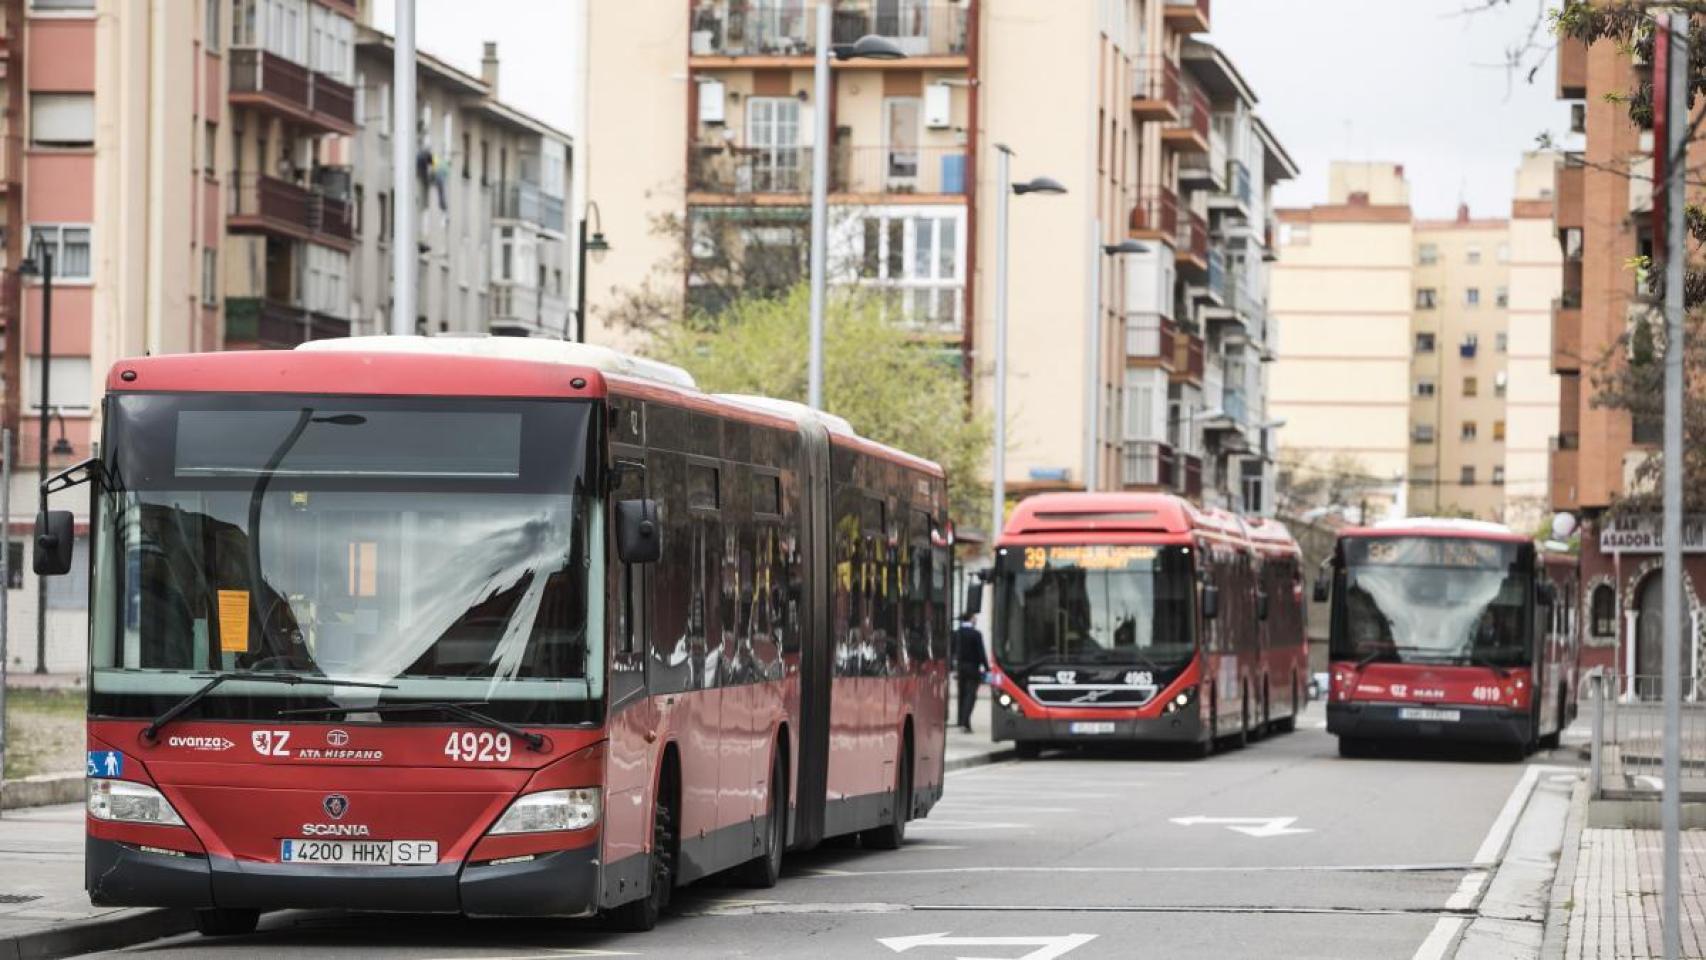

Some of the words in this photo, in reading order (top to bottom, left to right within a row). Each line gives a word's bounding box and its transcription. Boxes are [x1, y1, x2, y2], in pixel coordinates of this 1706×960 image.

[1603, 534, 1651, 546] ASADOR
[1024, 547, 1046, 570] 39
[1413, 689, 1445, 698] MAN
[168, 736, 222, 747] avanza
[444, 731, 511, 762] 4929
[299, 749, 321, 758] ATA
[325, 749, 384, 759] HISPANO
[302, 823, 370, 836] SCANIA
[297, 843, 343, 861] 4200
[352, 844, 387, 862] HHX
